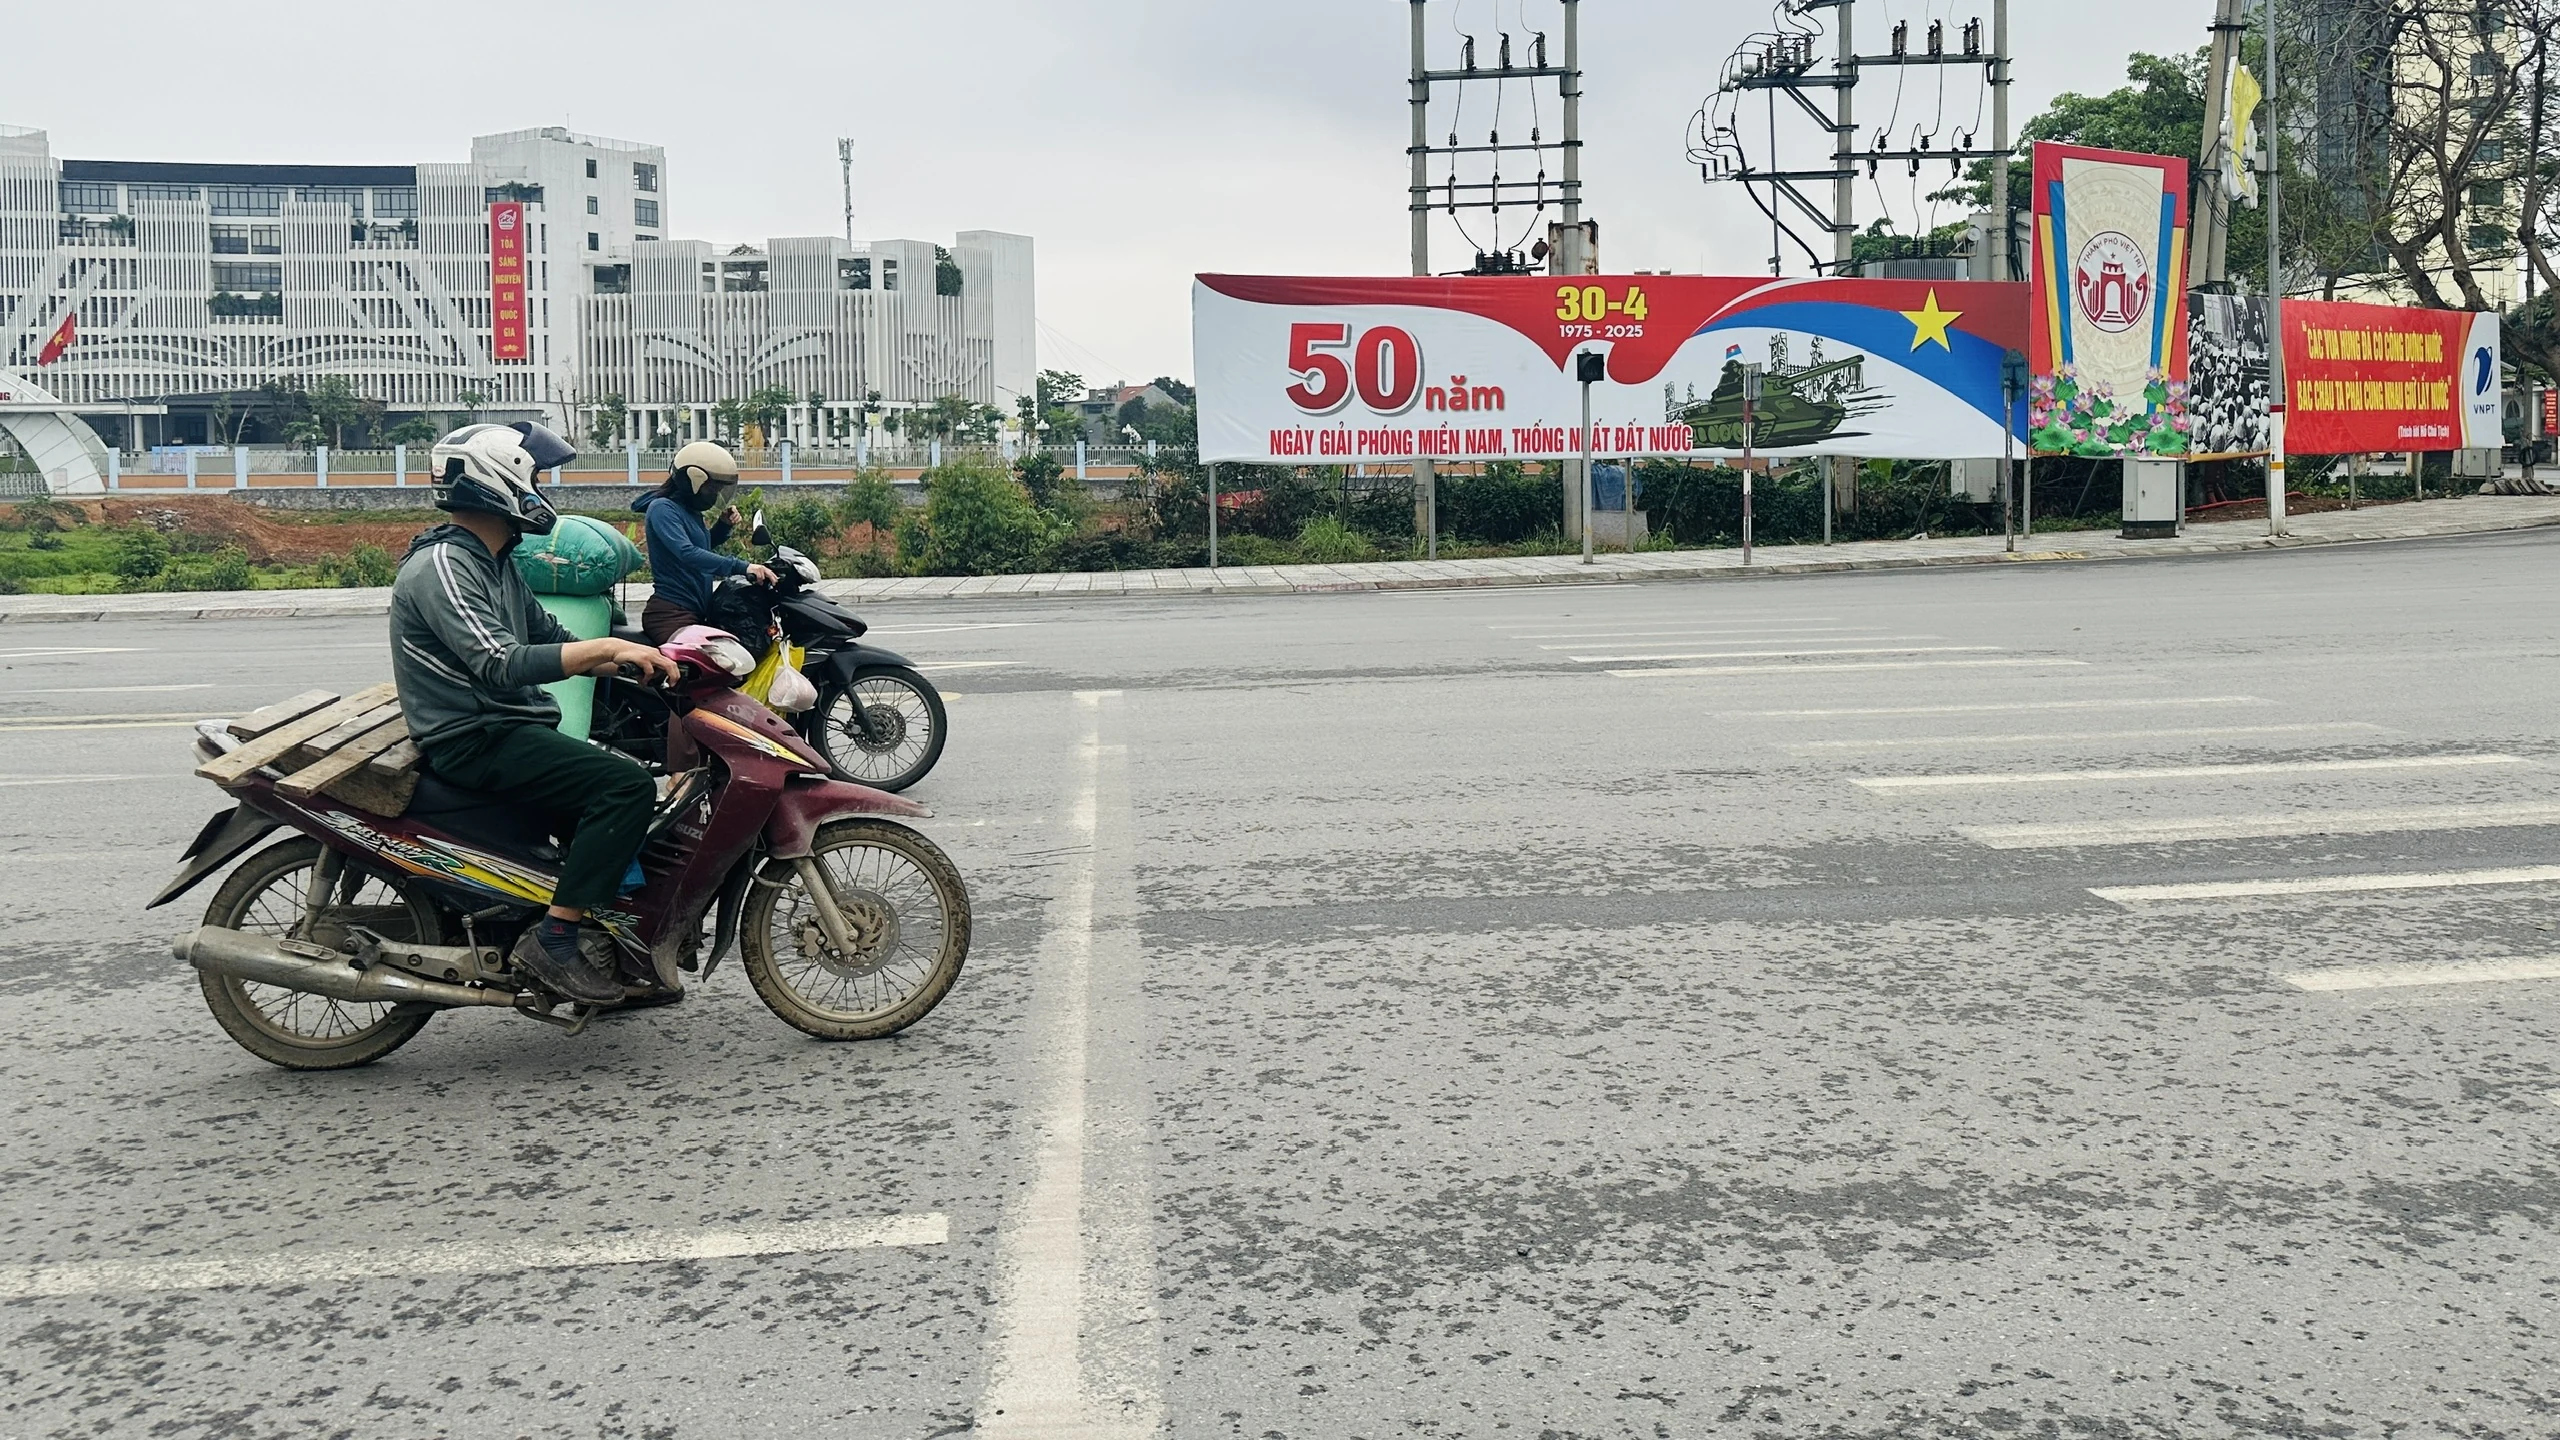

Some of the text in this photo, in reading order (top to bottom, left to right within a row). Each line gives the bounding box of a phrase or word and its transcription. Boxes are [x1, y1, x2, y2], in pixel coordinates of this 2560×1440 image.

[498, 254, 517, 267] SÁNG
[495, 273, 521, 285] NGUYÊN
[1555, 285, 1648, 321] 30-4
[500, 305, 518, 321] QUỐC
[503, 327, 516, 338] GIA
[1559, 324, 1593, 338] 1975
[1604, 324, 1644, 338] 2025
[2323, 329, 2340, 360] VUA
[2339, 324, 2361, 361] HÙNG
[2361, 325, 2373, 361] ĐÃ
[2373, 325, 2384, 361] CÓ
[2384, 325, 2404, 362] CÔNG
[1285, 322, 1505, 412] 50 năm
[2296, 373, 2313, 411] BÁC
[2314, 373, 2335, 411] CHÁU
[2334, 380, 2345, 411] TA
[2345, 370, 2363, 411] PHẢI
[2363, 374, 2384, 411] CÙNG
[2384, 381, 2404, 411] NHAU
[2404, 376, 2417, 411] GIỮ
[2417, 371, 2431, 411] LẤY
[2473, 404, 2496, 415] VNPT
[1270, 417, 1693, 457] NGÀY GIẢI PHÓNG MIỀN NAM, THỐNG NẤT ĐẤT NƯỚC
